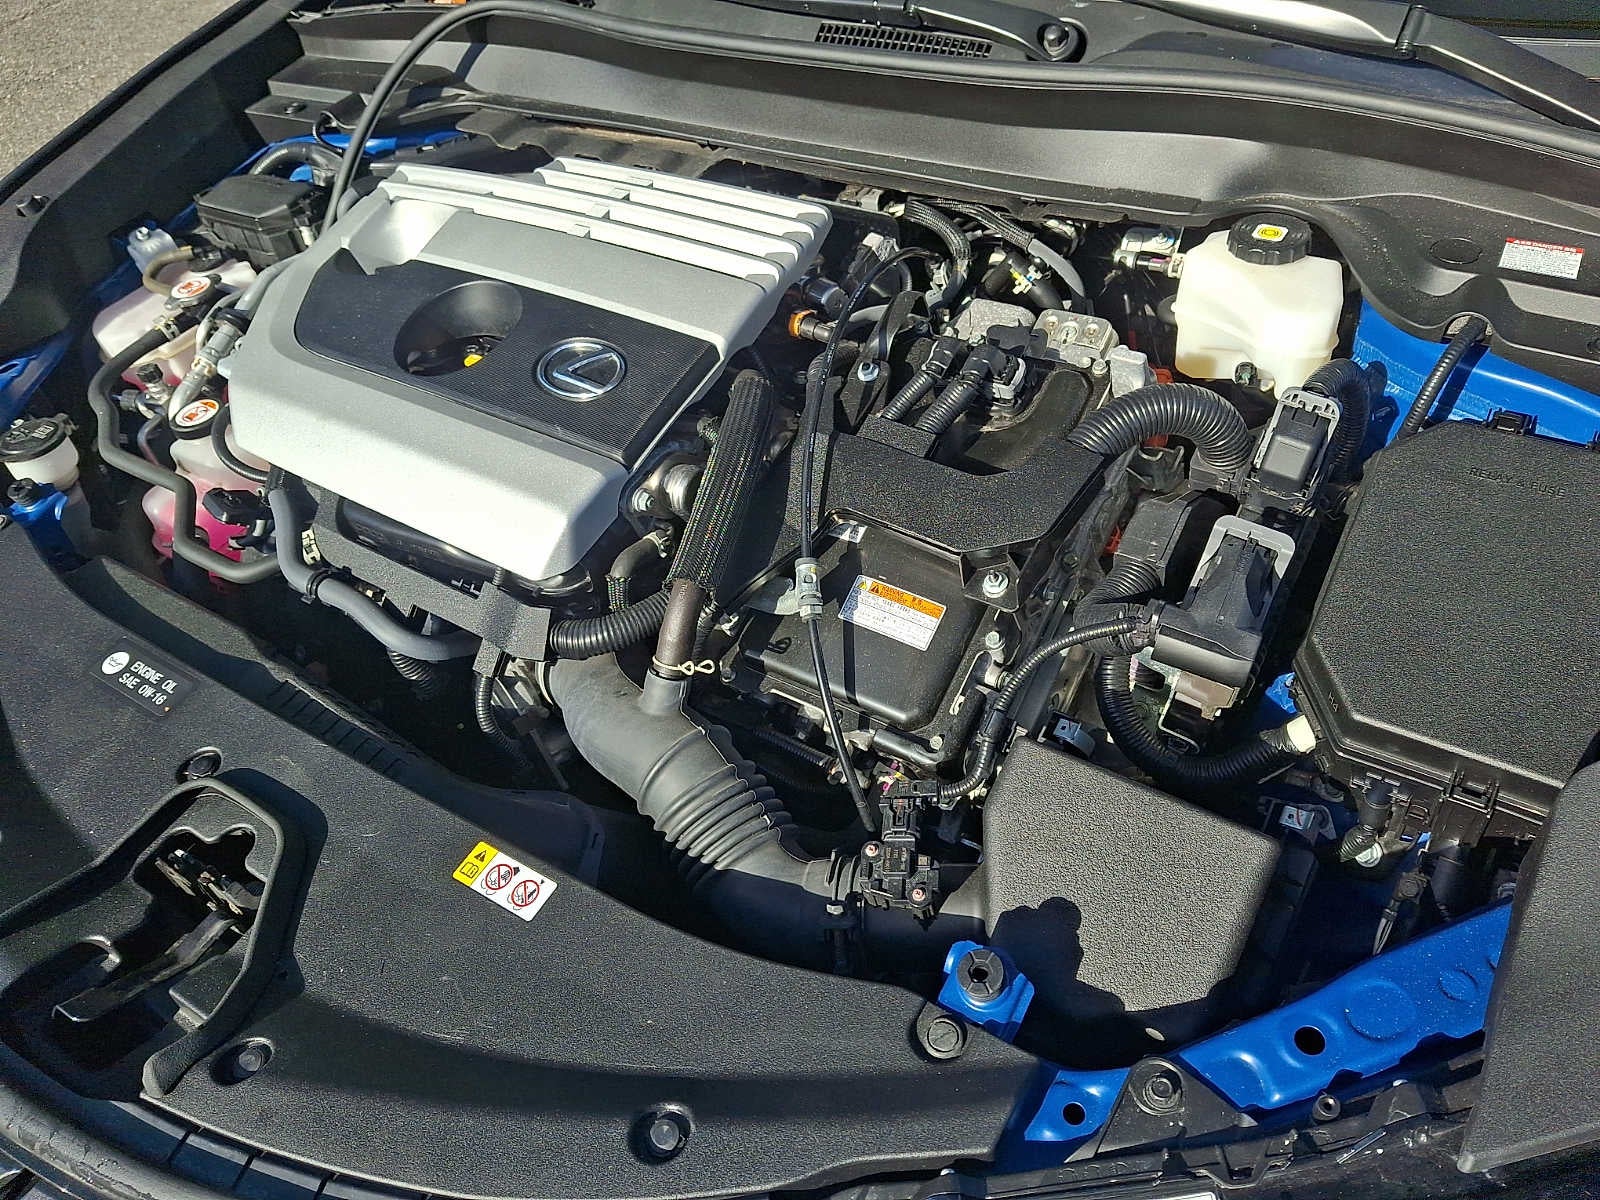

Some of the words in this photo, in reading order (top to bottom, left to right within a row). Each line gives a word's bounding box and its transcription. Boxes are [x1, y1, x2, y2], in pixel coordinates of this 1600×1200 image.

[1468, 466, 1513, 484] RELAY
[1530, 481, 1567, 498] FUSE
[118, 672, 141, 690] SAE
[137, 684, 167, 706] 0W-16
[130, 660, 164, 684] ENGINE
[161, 679, 178, 694] OIL
